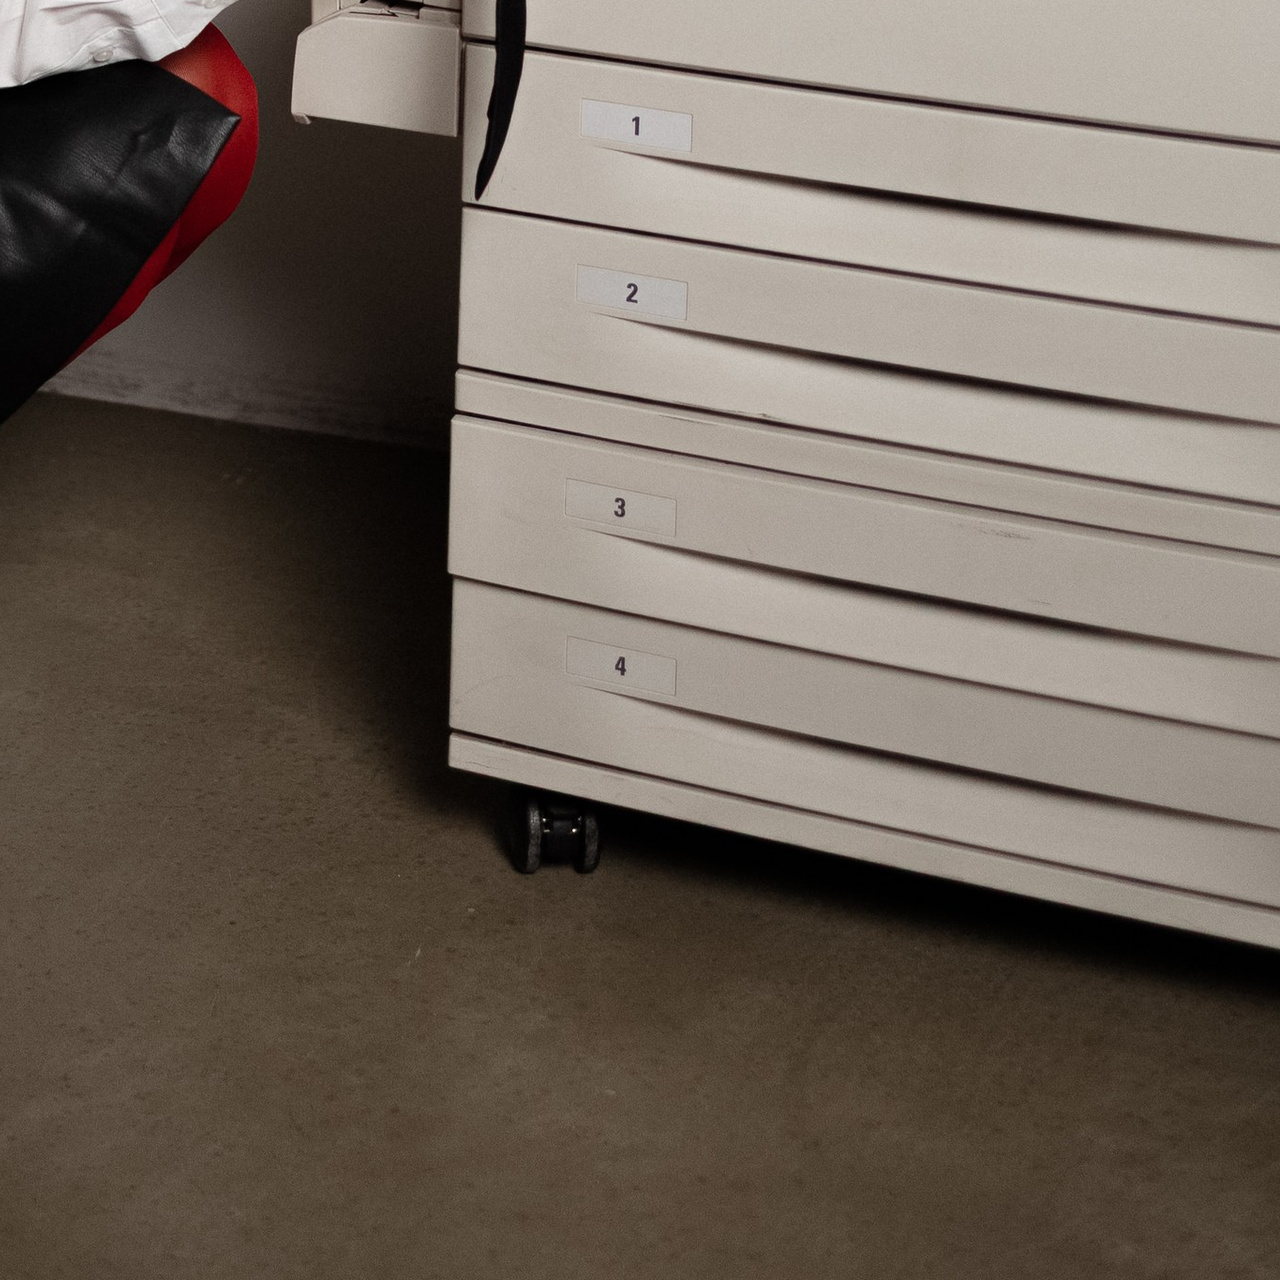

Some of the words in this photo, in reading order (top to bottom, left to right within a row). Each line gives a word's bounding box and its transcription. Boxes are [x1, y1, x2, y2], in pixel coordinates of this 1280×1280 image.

[630, 115, 642, 137] 1
[624, 282, 640, 305] 2
[612, 496, 627, 519] 3
[613, 655, 628, 678] 4
